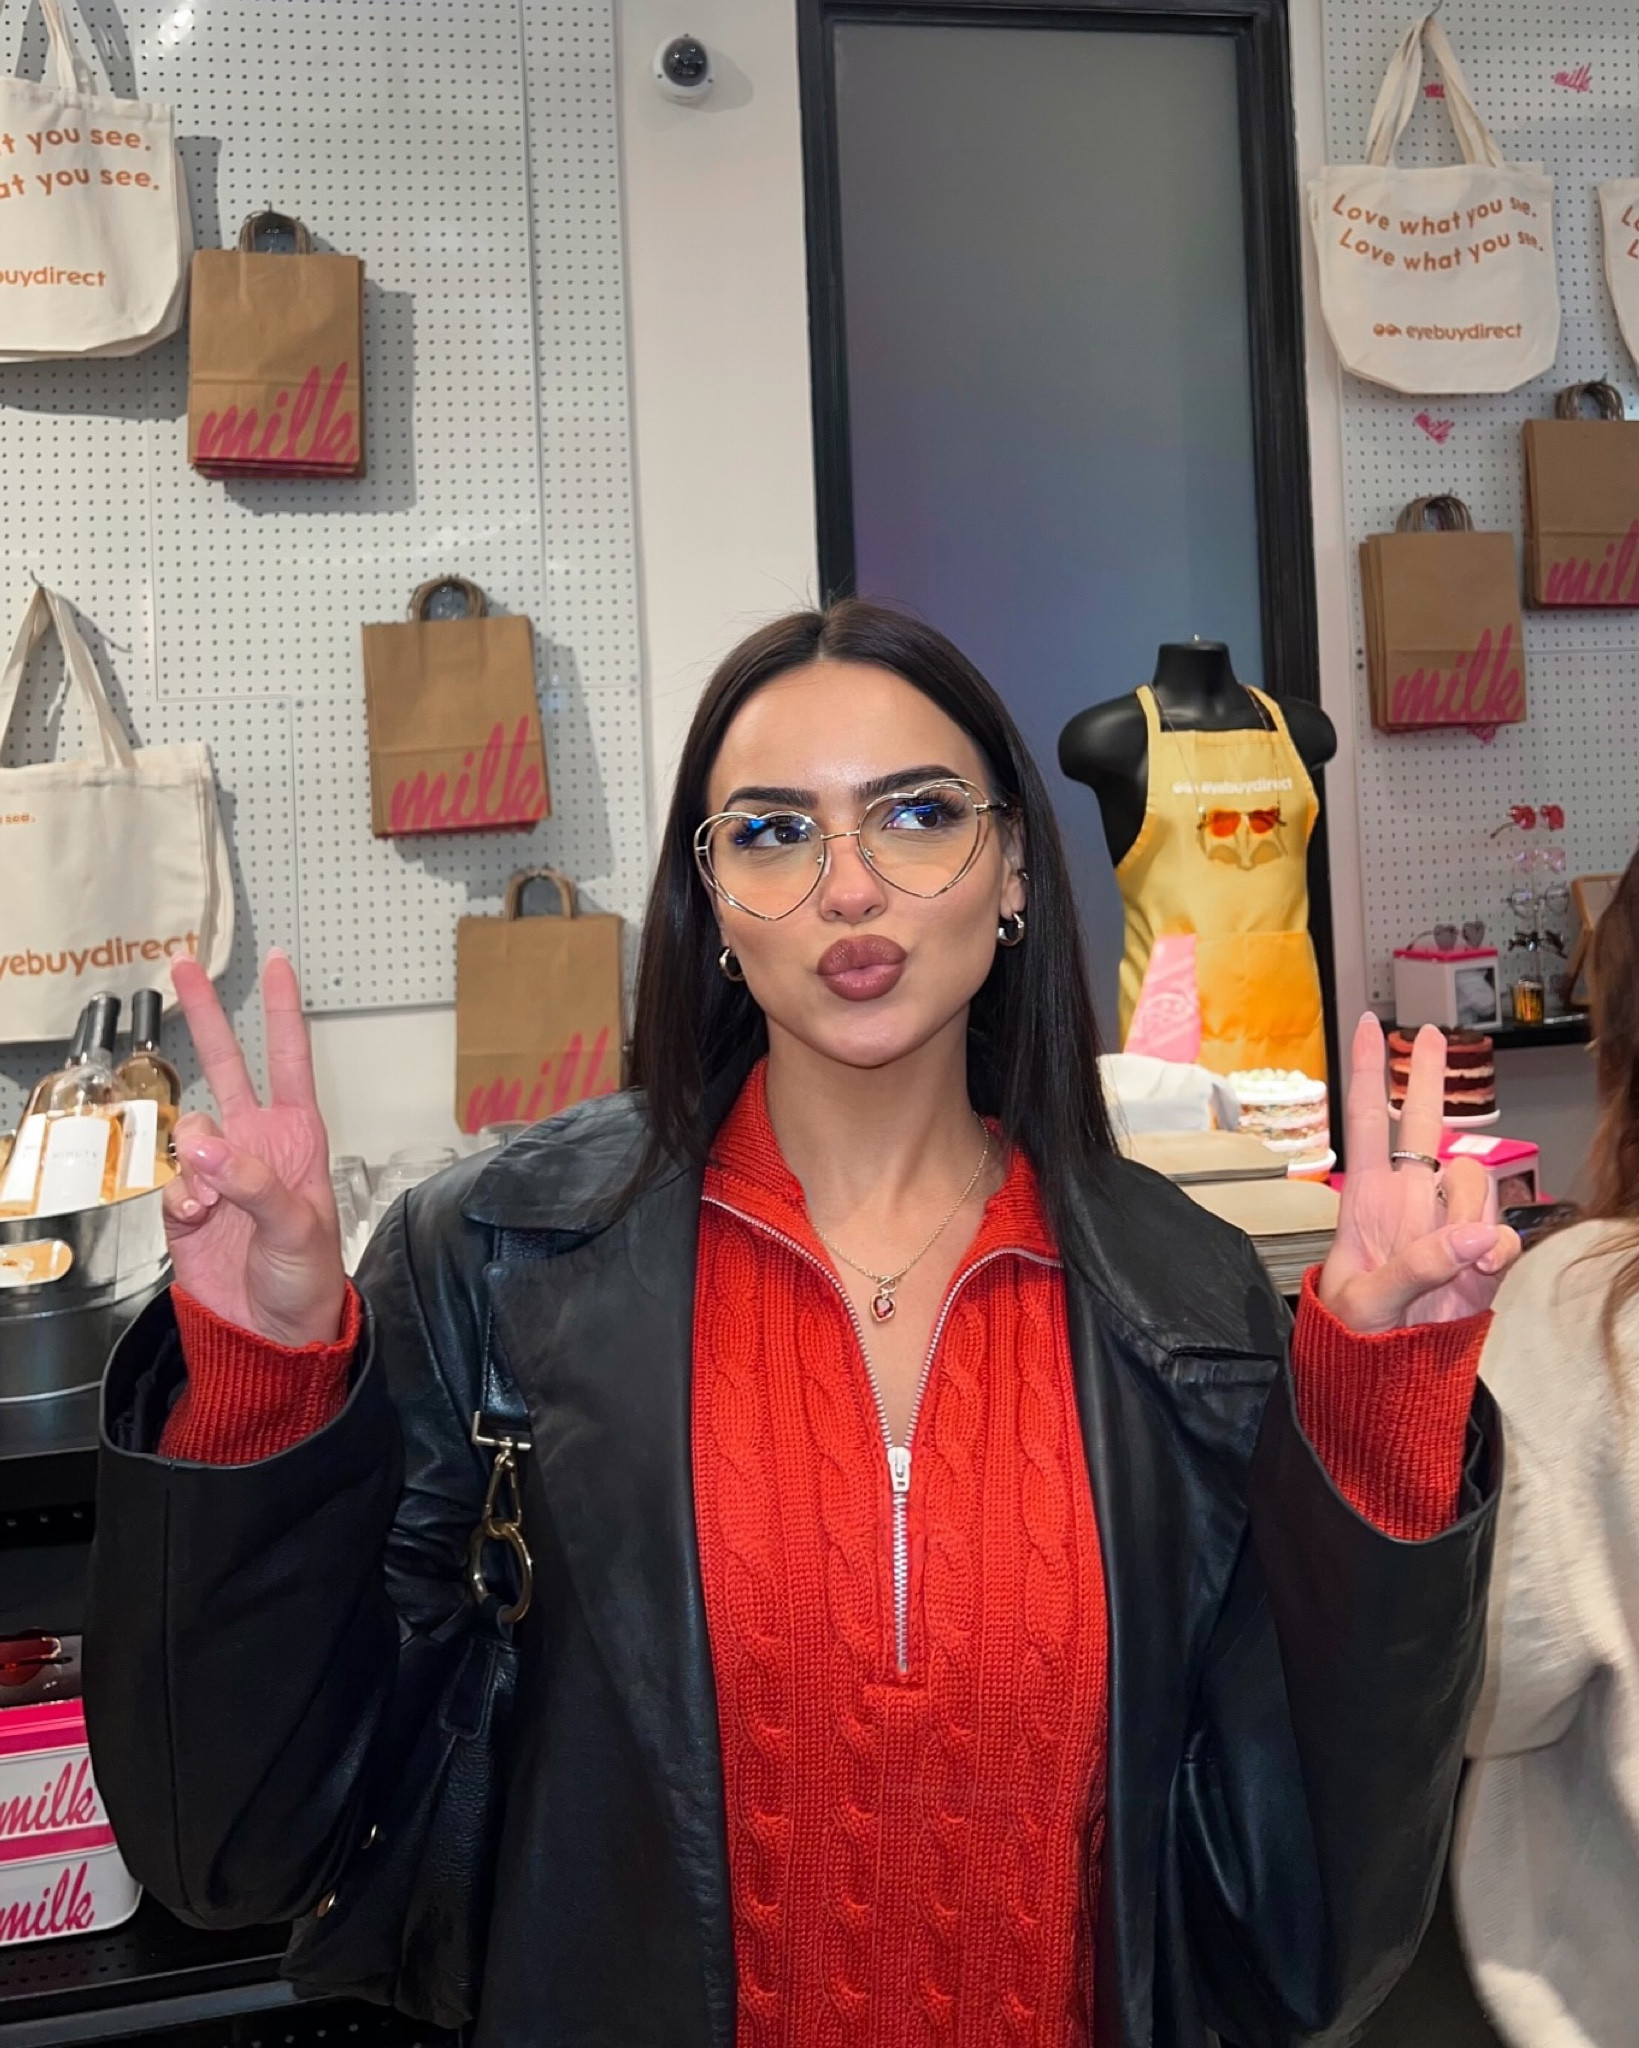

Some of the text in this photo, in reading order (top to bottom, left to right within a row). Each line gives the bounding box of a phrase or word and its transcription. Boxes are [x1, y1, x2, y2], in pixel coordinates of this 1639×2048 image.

[26, 128, 81, 155] you
[90, 128, 152, 151] see.
[36, 168, 90, 196] you
[100, 168, 160, 190] see.
[1332, 194, 1390, 231] Love
[1400, 211, 1460, 235] what
[1466, 199, 1503, 228] you
[1339, 228, 1396, 266] Love
[1403, 247, 1461, 271] what
[1468, 233, 1511, 263] you
[1406, 323, 1522, 341] eyebuydirect
[196, 361, 360, 462] milk
[1392, 623, 1525, 722] milk
[389, 714, 547, 829] milk
[0, 1757, 97, 1836] milk
[0, 1862, 95, 1940] milk
